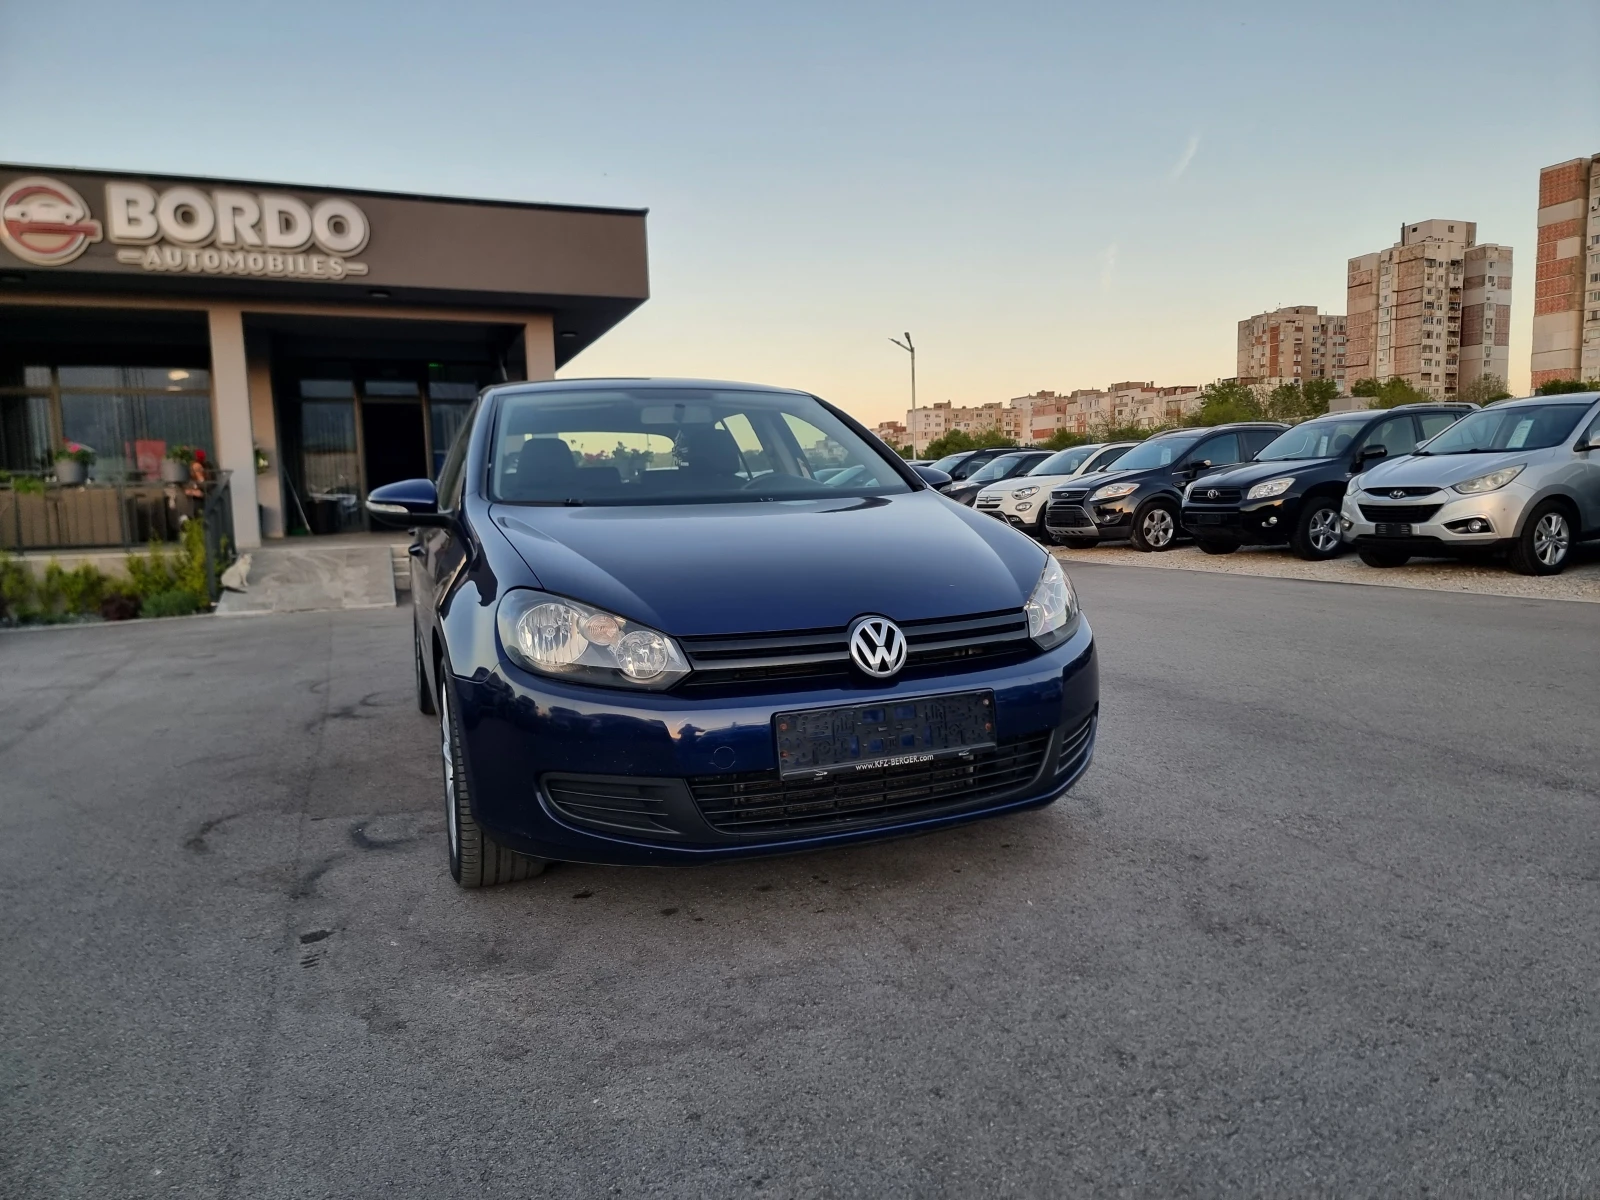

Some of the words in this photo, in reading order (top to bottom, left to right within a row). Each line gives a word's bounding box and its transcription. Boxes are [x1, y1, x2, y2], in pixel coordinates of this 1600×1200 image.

[106, 183, 369, 255] BORDO
[146, 247, 345, 277] AUTOMOBILES
[855, 754, 934, 770] www.KFZ-BERGER.com
